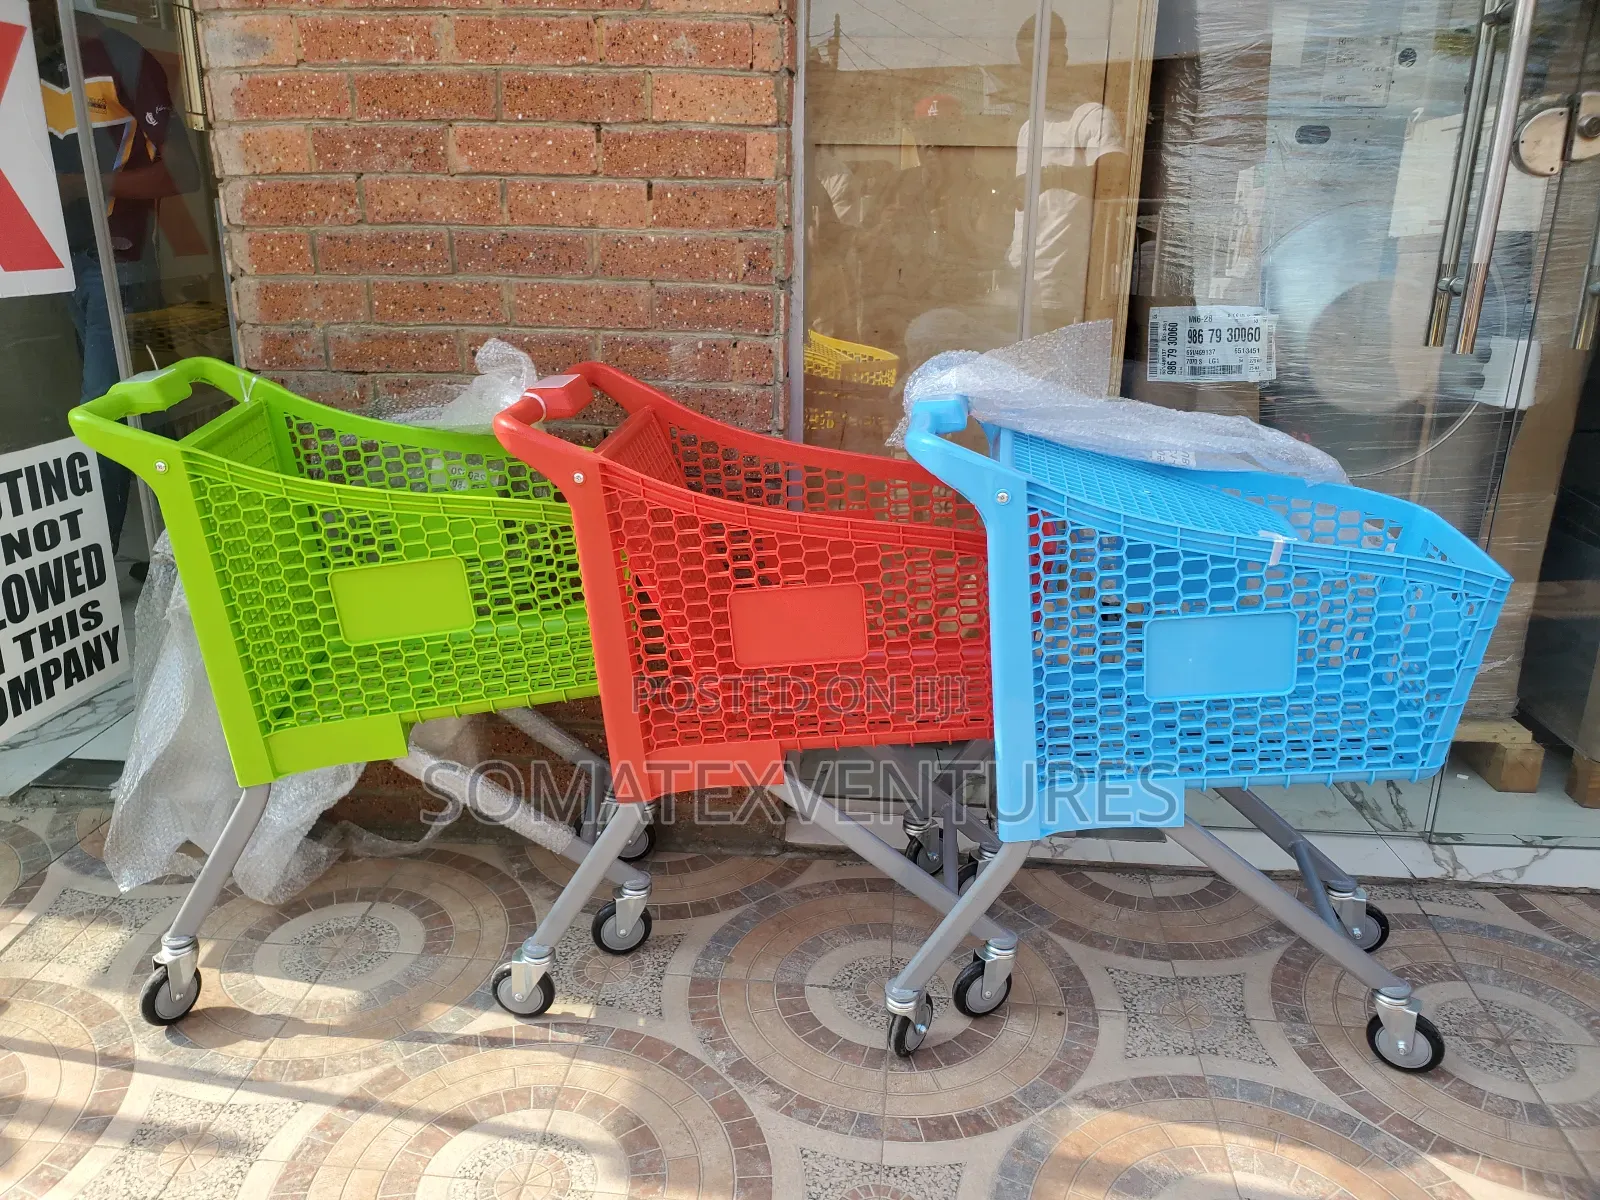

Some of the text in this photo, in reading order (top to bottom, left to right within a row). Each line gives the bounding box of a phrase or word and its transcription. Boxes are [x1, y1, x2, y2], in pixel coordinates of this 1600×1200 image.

[1166, 322, 1178, 375] 986 79 30060
[1187, 326, 1261, 345] 986 79 30060
[0, 452, 93, 519] TING
[1, 508, 84, 566] NOT
[0, 542, 107, 631] OWED
[13, 599, 104, 664] THIS
